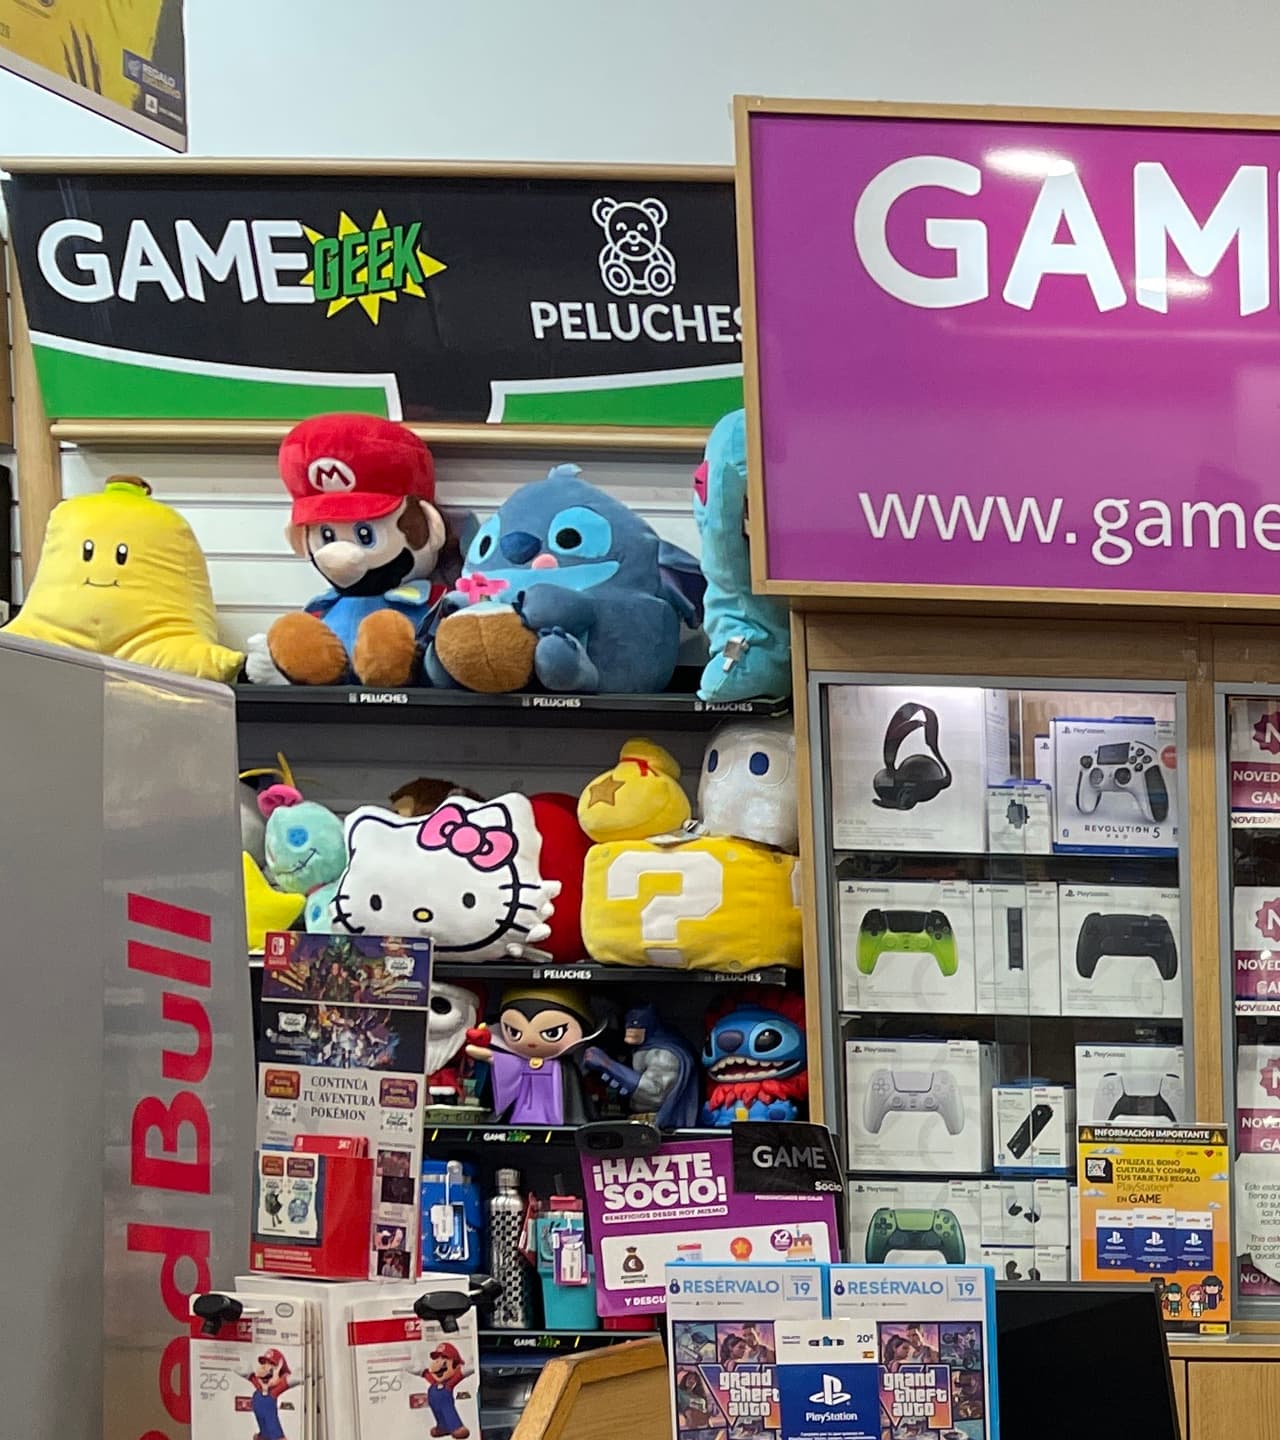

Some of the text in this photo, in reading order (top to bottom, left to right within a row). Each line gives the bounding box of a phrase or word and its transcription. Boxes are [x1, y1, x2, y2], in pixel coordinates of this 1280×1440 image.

[38, 219, 425, 303] GAME GEEK
[360, 692, 408, 705] PELUCHES
[1084, 824, 1150, 835] REVOLUTION
[544, 969, 592, 980] PELUCHES
[127, 893, 213, 1195] Bull
[309, 1105, 367, 1121] POKÉMON
[1094, 1128, 1210, 1138] INFORMACIÓN IMPORTANTE
[593, 1152, 712, 1191] ¡HAZTE
[603, 1176, 727, 1210] SOCIO!
[1128, 1194, 1162, 1204] GAME
[682, 1278, 811, 1296] RESÉRVALO 19
[806, 1411, 859, 1423] PlayStation
